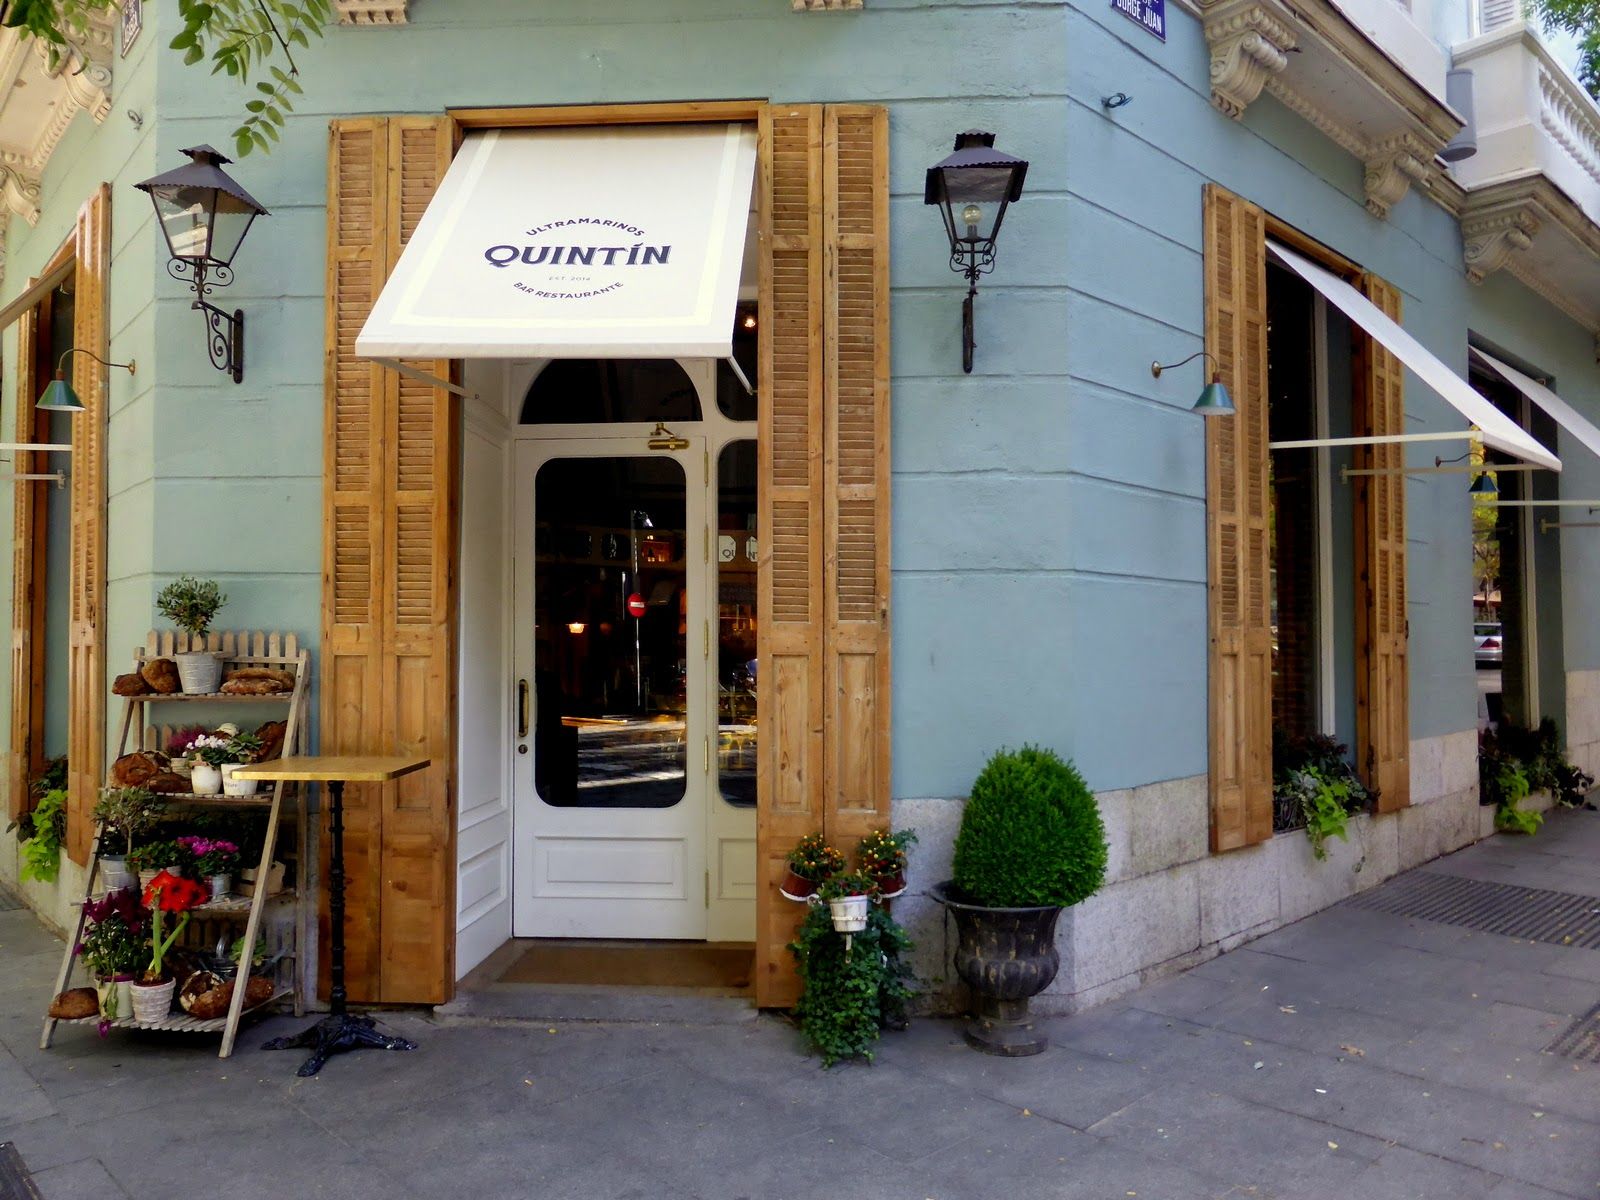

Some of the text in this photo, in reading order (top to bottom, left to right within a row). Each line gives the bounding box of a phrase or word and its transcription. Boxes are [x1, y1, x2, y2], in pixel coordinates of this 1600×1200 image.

[1143, 7, 1162, 34] JUAN
[525, 217, 645, 237] ULTRAMARINOS
[484, 241, 672, 269] QUINTÍN
[513, 281, 624, 299] BAR RESTAURANTE
